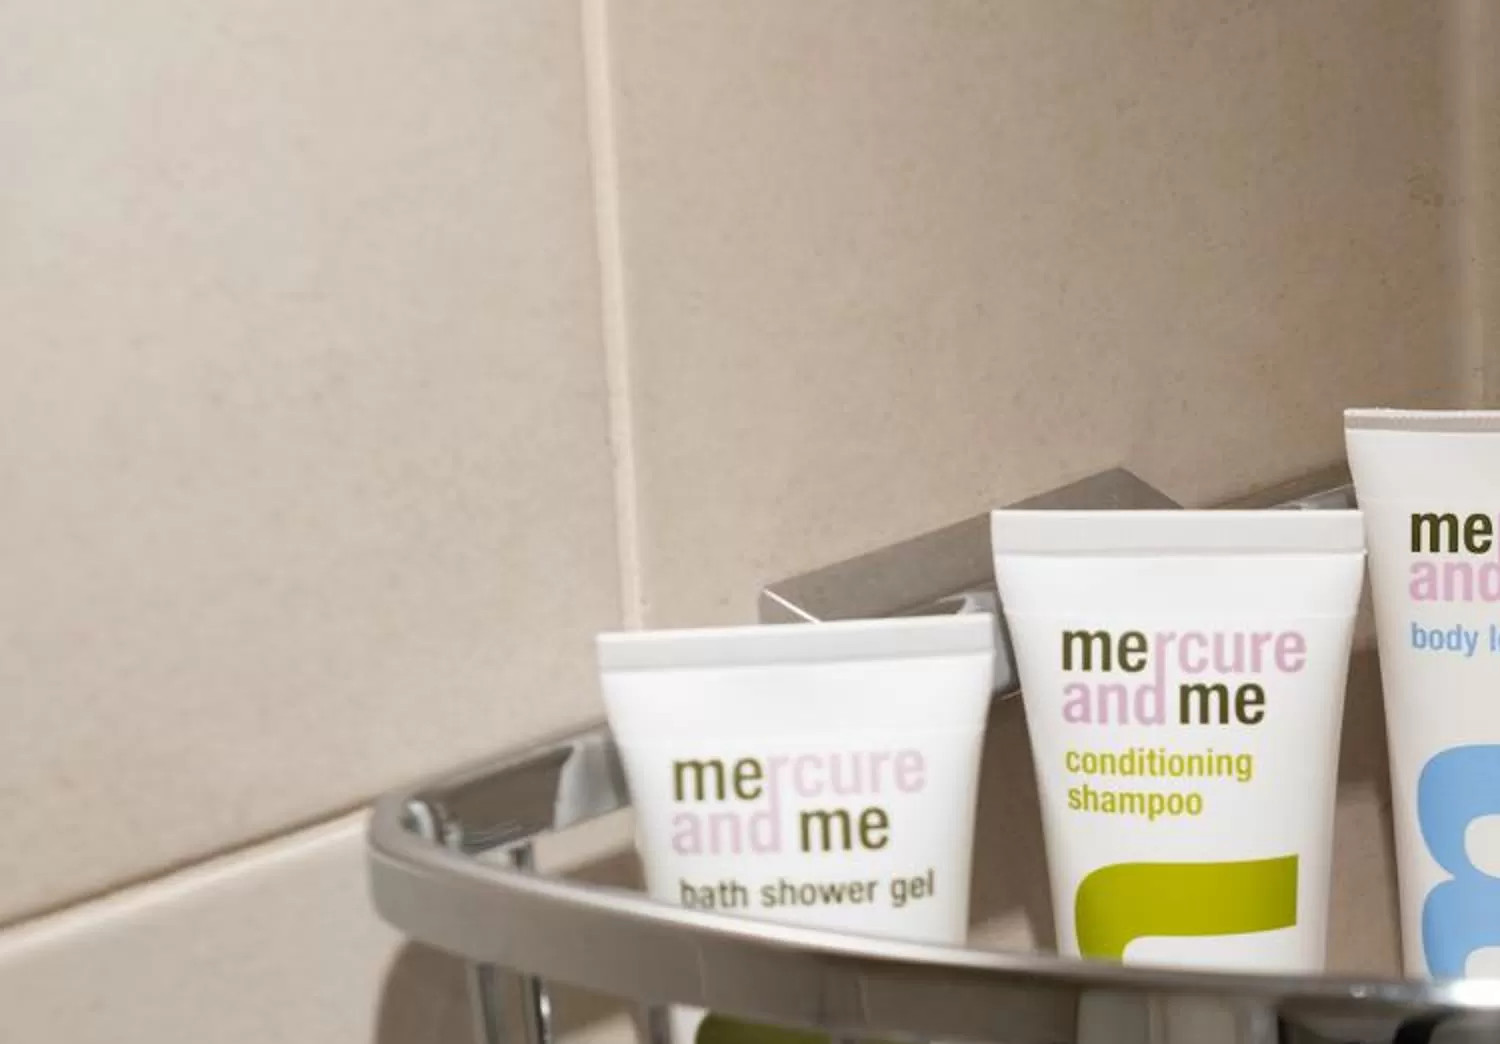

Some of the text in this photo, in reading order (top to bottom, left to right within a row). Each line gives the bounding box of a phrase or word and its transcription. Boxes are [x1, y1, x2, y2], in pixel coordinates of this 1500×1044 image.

[1060, 629, 1308, 674] mercure
[1410, 621, 1479, 658] body
[1061, 675, 1267, 727] and me
[671, 748, 927, 802] mercure
[1064, 747, 1254, 783] conditioning
[1066, 783, 1205, 822] shampoo
[670, 802, 891, 858] and me
[678, 867, 935, 910] bath shower gel
